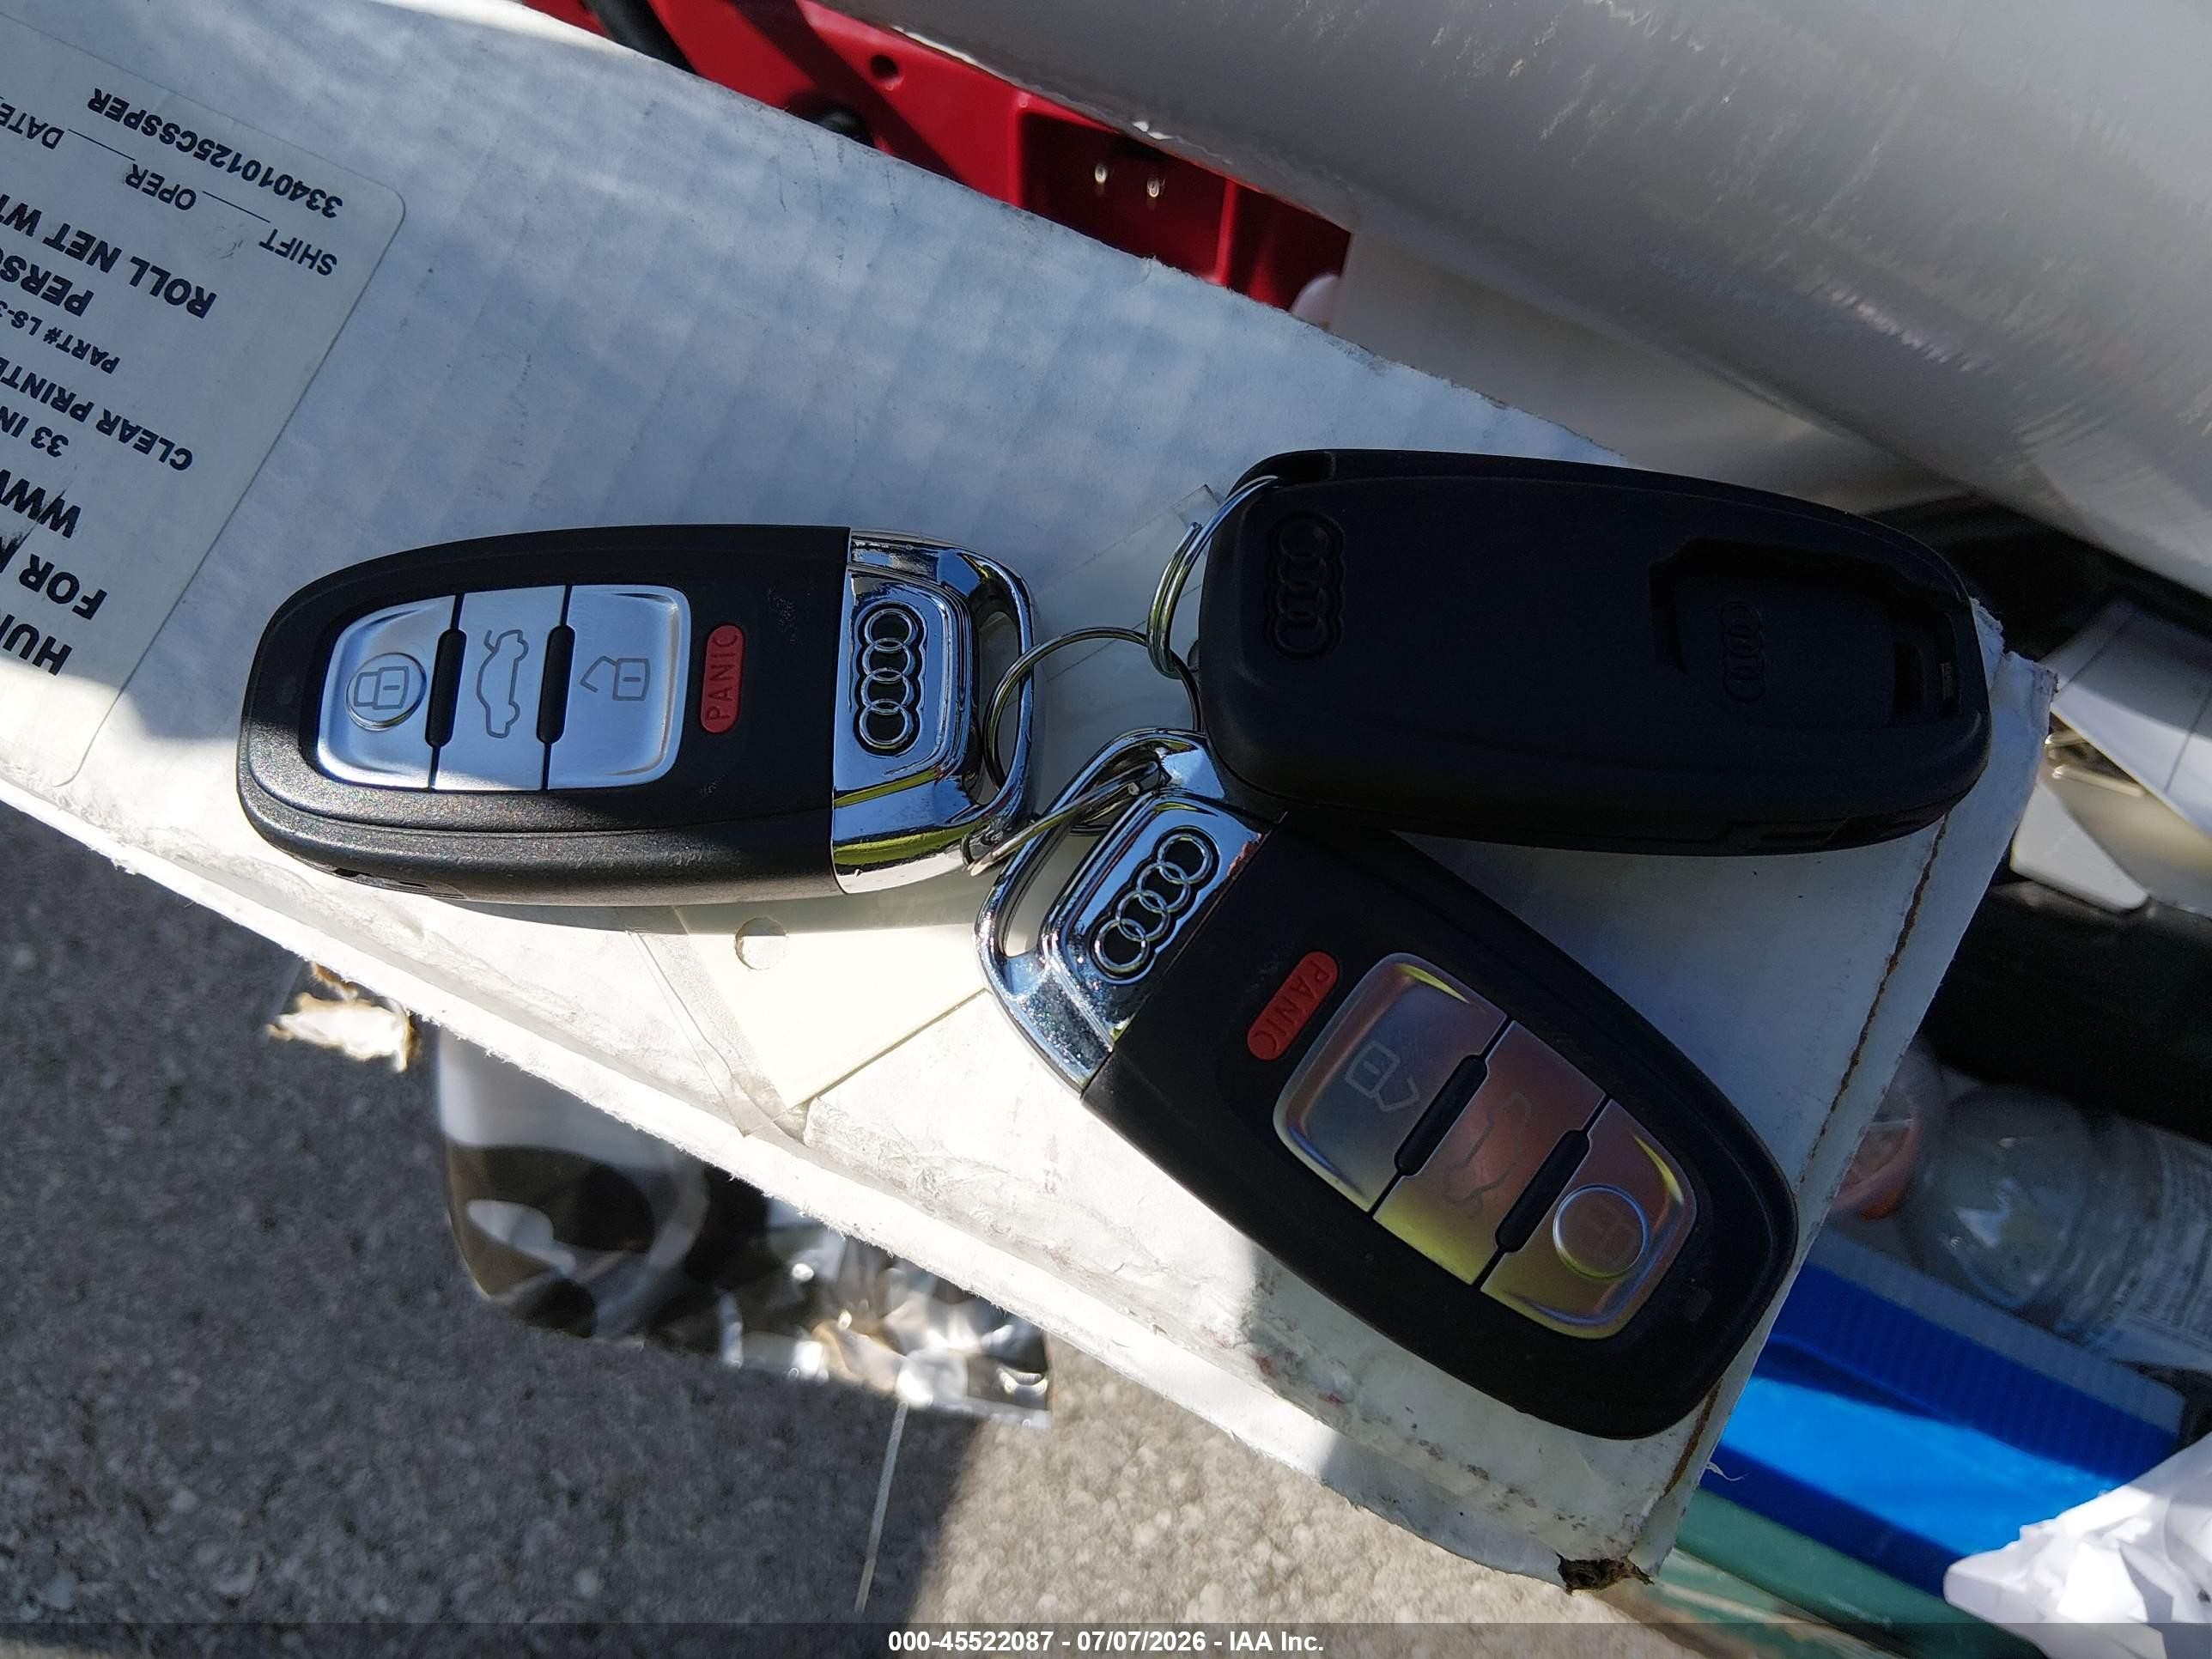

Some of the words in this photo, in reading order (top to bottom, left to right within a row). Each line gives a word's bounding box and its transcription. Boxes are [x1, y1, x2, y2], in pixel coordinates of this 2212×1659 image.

[88, 88, 343, 219] 334010125CSSPER
[125, 163, 197, 210] OPER
[43, 222, 123, 274] NET
[258, 228, 337, 276] SHIFT
[0, 247, 94, 317] PERS
[130, 256, 216, 317] ROLL
[43, 326, 120, 374] PART#
[31, 426, 70, 458] 33
[95, 408, 193, 471] CLEAR
[0, 469, 81, 538] WW
[19, 554, 107, 620] FOR
[705, 634, 738, 721] PANIC
[1252, 959, 1331, 1054] PANIC
